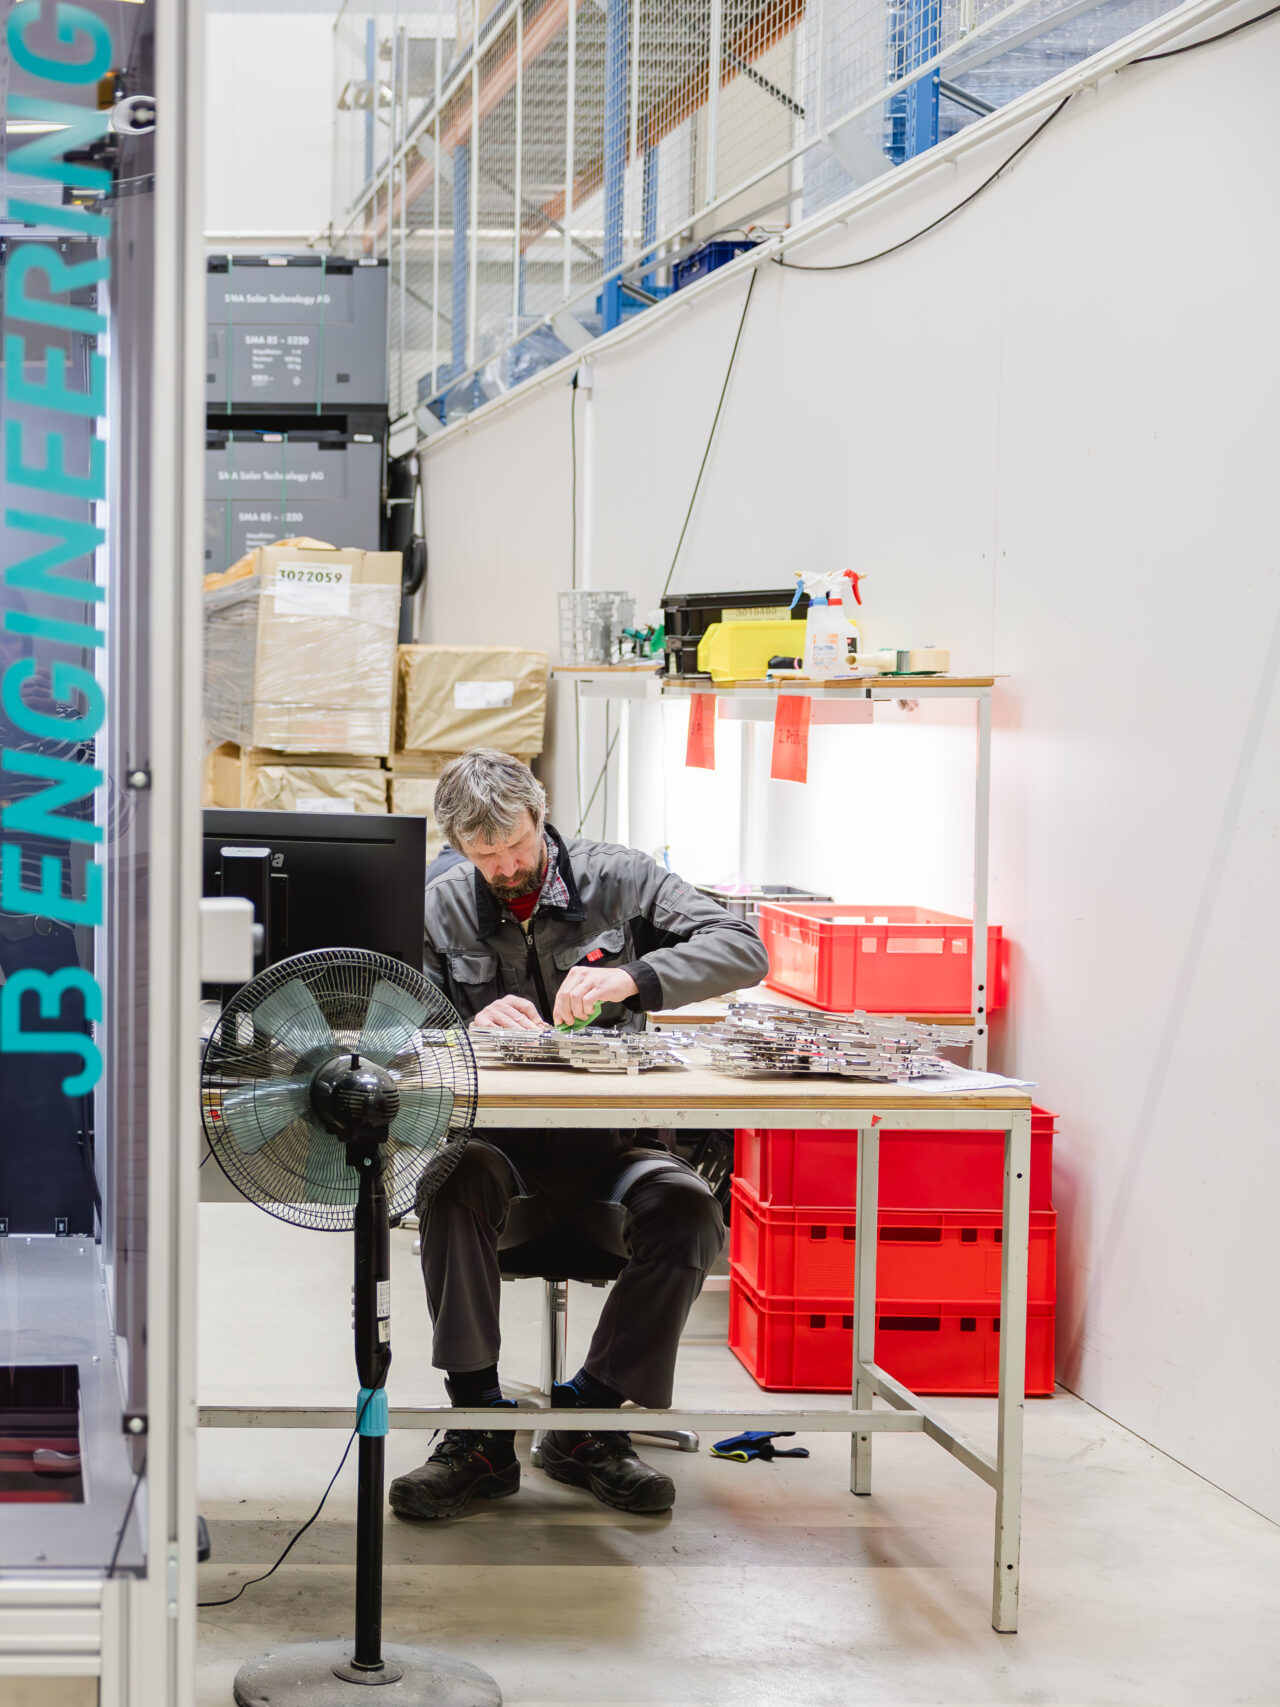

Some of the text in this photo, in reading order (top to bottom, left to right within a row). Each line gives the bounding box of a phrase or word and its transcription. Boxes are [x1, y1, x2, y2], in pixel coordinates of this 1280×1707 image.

[246, 294, 268, 304] Solar
[269, 294, 316, 306] Technology
[240, 471, 262, 481] Solar
[310, 471, 324, 481] AG
[0, 0, 113, 1098] JB ENGINEERING
[279, 569, 343, 584] 3022059
